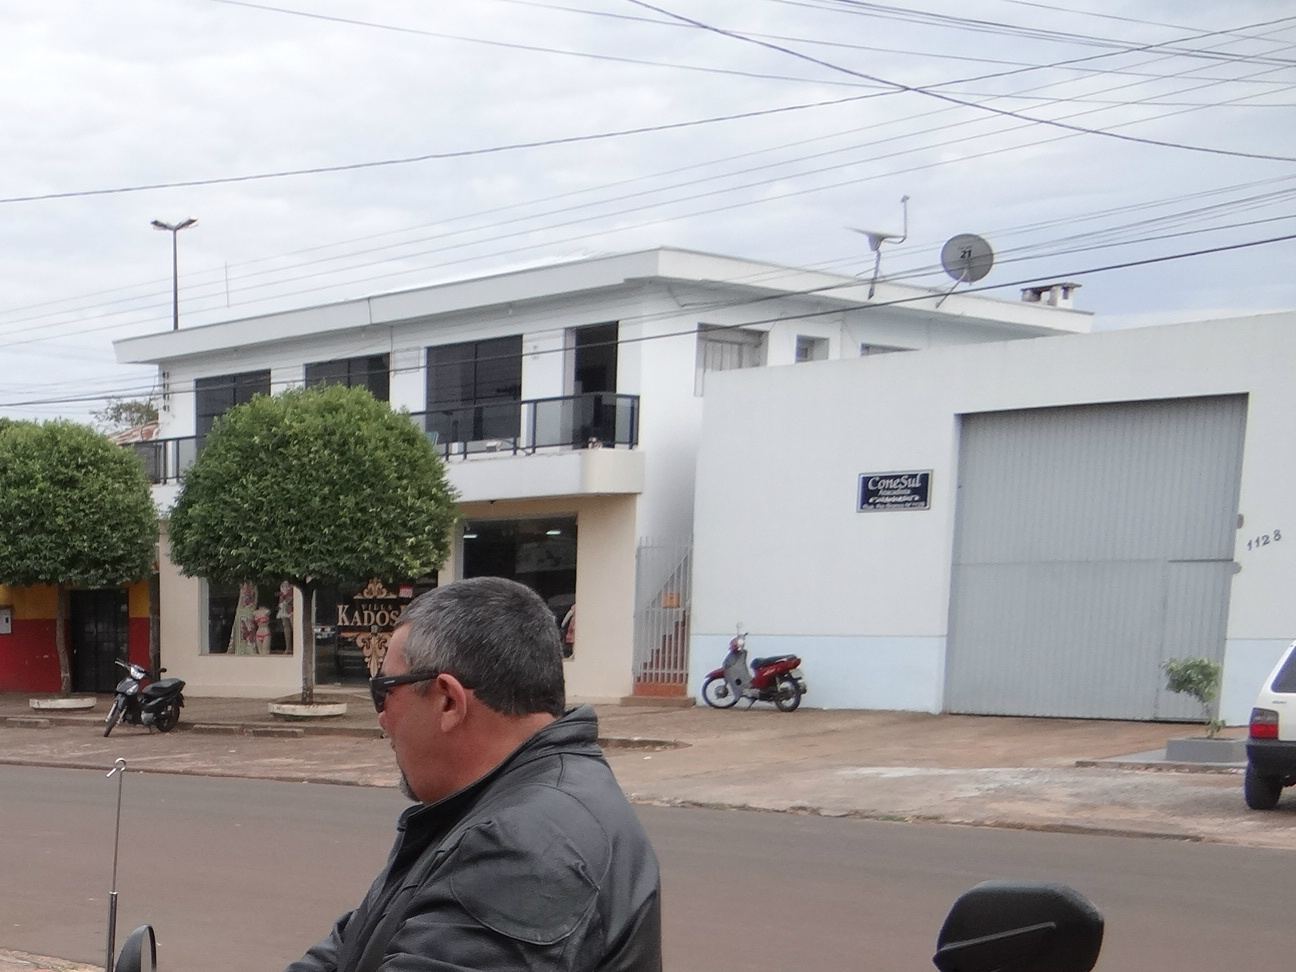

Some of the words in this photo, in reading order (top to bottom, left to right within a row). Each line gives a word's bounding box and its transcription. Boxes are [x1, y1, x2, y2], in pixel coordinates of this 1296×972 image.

[868, 472, 921, 490] ConeSul
[1247, 529, 1282, 551] 1128
[336, 604, 407, 627] KADOS
[361, 603, 393, 611] VILLA
